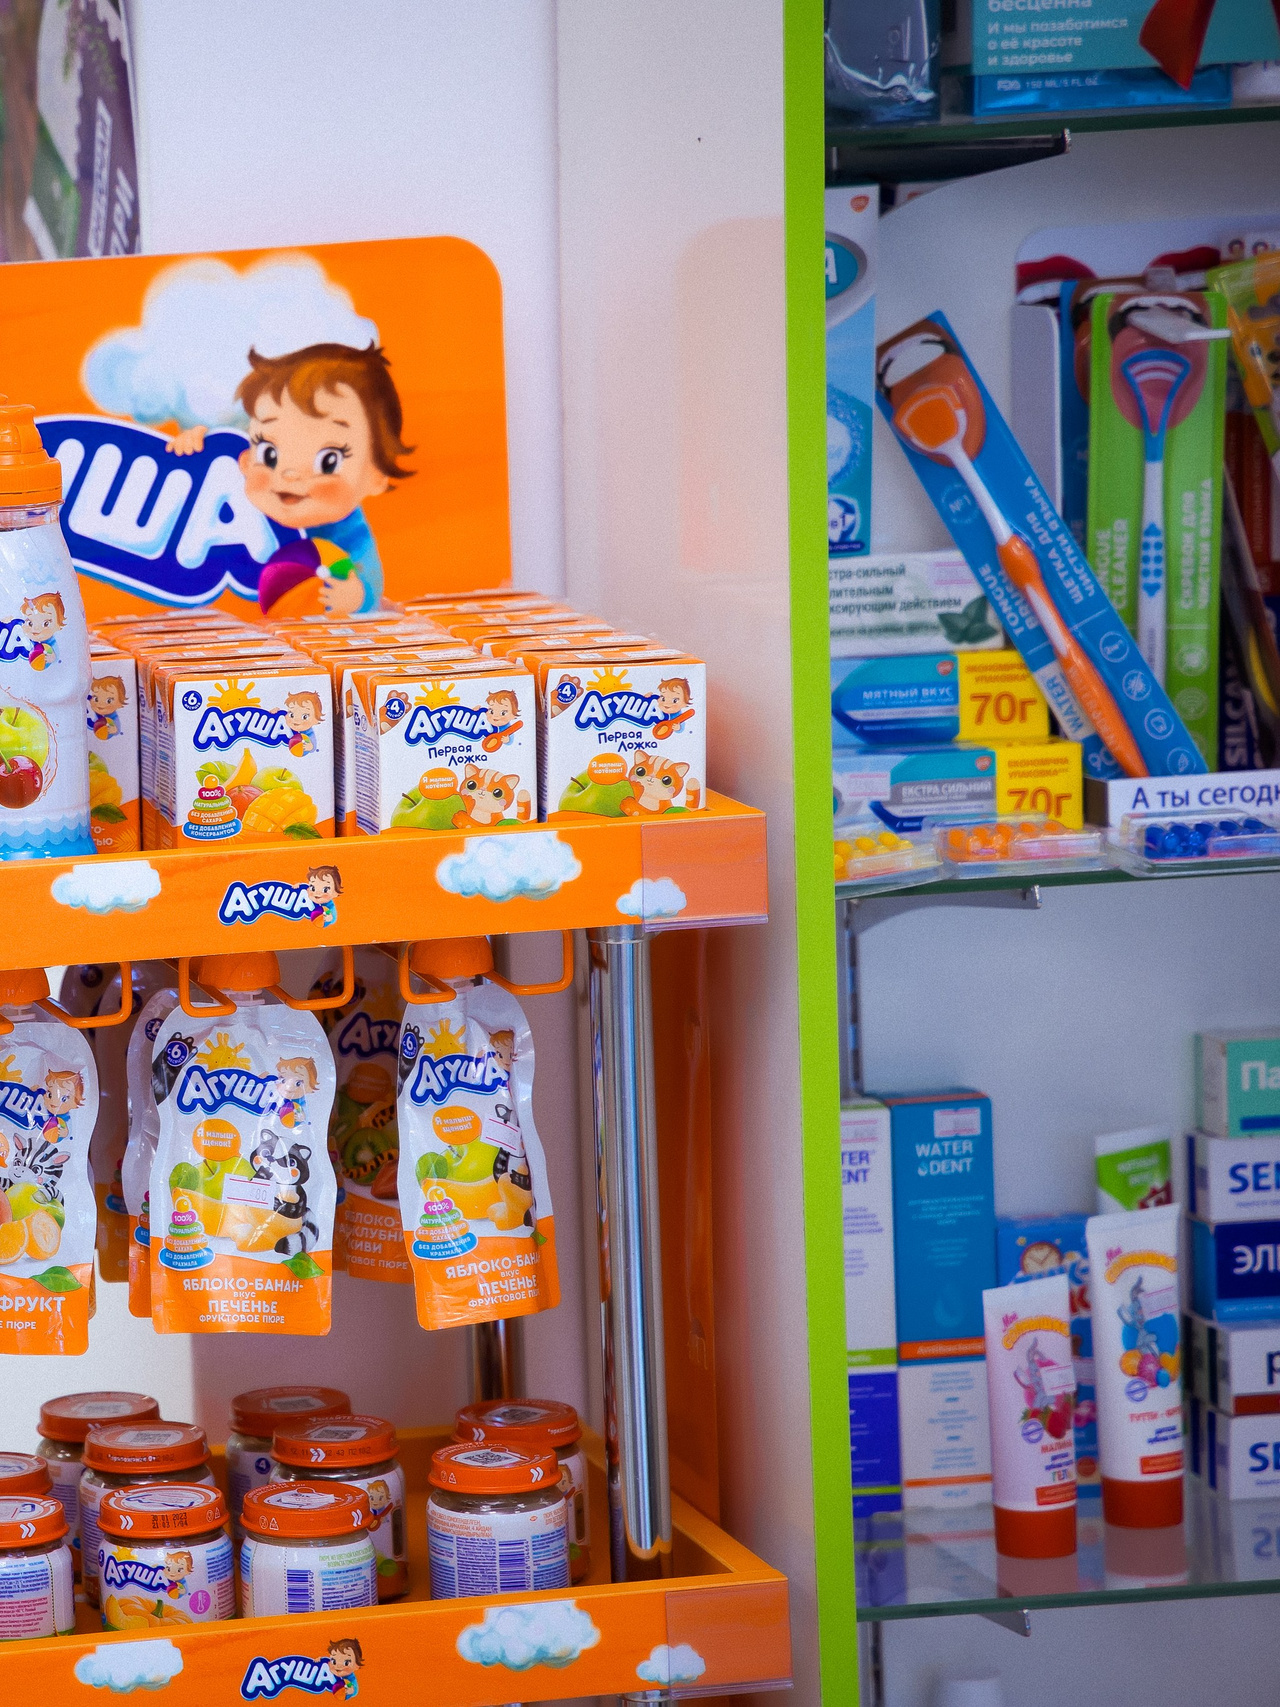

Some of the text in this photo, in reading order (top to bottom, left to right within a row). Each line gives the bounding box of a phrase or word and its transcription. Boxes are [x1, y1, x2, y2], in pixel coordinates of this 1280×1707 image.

[988, 18, 1128, 34] И мы позаботимся
[988, 41, 997, 50] о
[1023, 37, 1082, 50] красоте
[988, 53, 1073, 66] и здоровье
[1024, 475, 1095, 597] ЧИСТКИ ЯЗЫКА
[1026, 511, 1084, 605] ЩЕТКА ДЛЯ
[1112, 519, 1128, 609] CLEANER
[899, 597, 961, 612] действием
[978, 563, 1025, 638] TONGUE
[562, 685, 571, 697] 4
[862, 688, 918, 700] МЯТНЫЙ
[187, 693, 195, 705] 6
[1042, 675, 1083, 733] WATER
[391, 701, 399, 713] 4
[970, 691, 1037, 725] 70г
[598, 731, 642, 744] Первая
[428, 745, 472, 759] Первая
[618, 741, 658, 752] Ложка
[448, 755, 488, 766] Ложка
[202, 789, 221, 797] 100%
[1132, 787, 1149, 809] А
[1158, 790, 1189, 806] ты
[191, 828, 235, 837] КОНСЕРВАНТОВ
[199, 822, 236, 831] ДОБАВЛЕНИЯ
[341, 1018, 401, 1052] АГУ
[406, 1037, 414, 1050] 6
[172, 1045, 181, 1058] 6
[1240, 1061, 1280, 1092] Па
[435, 1117, 442, 1125] Я
[197, 1128, 236, 1139] Я малыш-
[915, 1140, 973, 1157] WATER
[841, 1150, 870, 1166] TER
[929, 1157, 973, 1175] DENT
[428, 1202, 449, 1212] 100%
[174, 1214, 192, 1222] 100%
[431, 1236, 471, 1250] ДОБАВЛЕНИЯ
[173, 1251, 207, 1259] ДОБАВЛЕНИЯ
[430, 1248, 462, 1257] КРАХМАЛА
[378, 1260, 409, 1270] ПЮРЕ
[500, 1269, 519, 1278] вкус
[183, 1278, 303, 1292] ЯБЛОКО-БАНАН-
[479, 1275, 537, 1296] ПЕЧЕНЬЕ
[233, 1291, 256, 1299] вкус
[468, 1291, 526, 1308] ФРУКТОВОЕ
[208, 1300, 278, 1313] ПЕЧЕНЬЕ
[6, 1321, 36, 1330] ПЮРЕ
[199, 1314, 285, 1324] ФРУКТОВОЕ ПЮРЕ
[1249, 1442, 1280, 1473] SE
